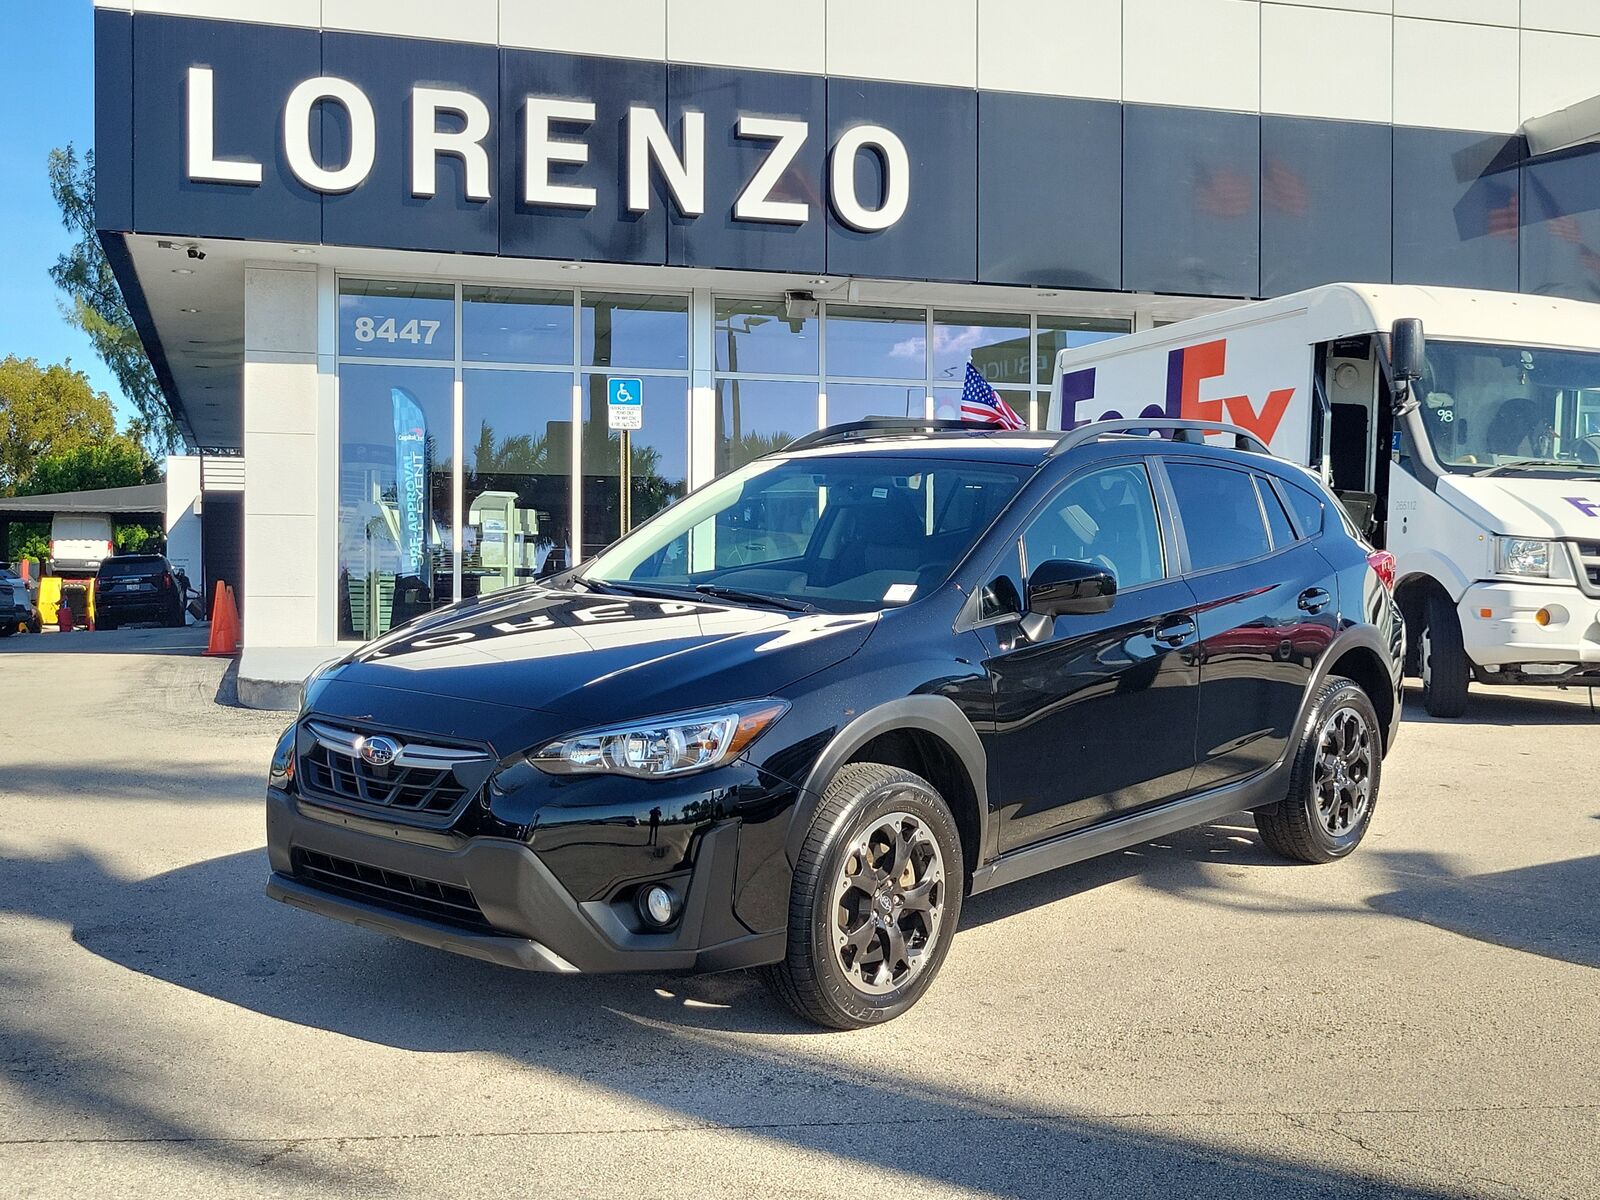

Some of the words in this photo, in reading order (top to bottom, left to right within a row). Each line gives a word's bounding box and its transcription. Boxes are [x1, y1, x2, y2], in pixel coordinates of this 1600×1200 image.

[186, 66, 911, 234] LORENZO
[354, 316, 440, 345] 8447
[1437, 409, 1454, 422] 98
